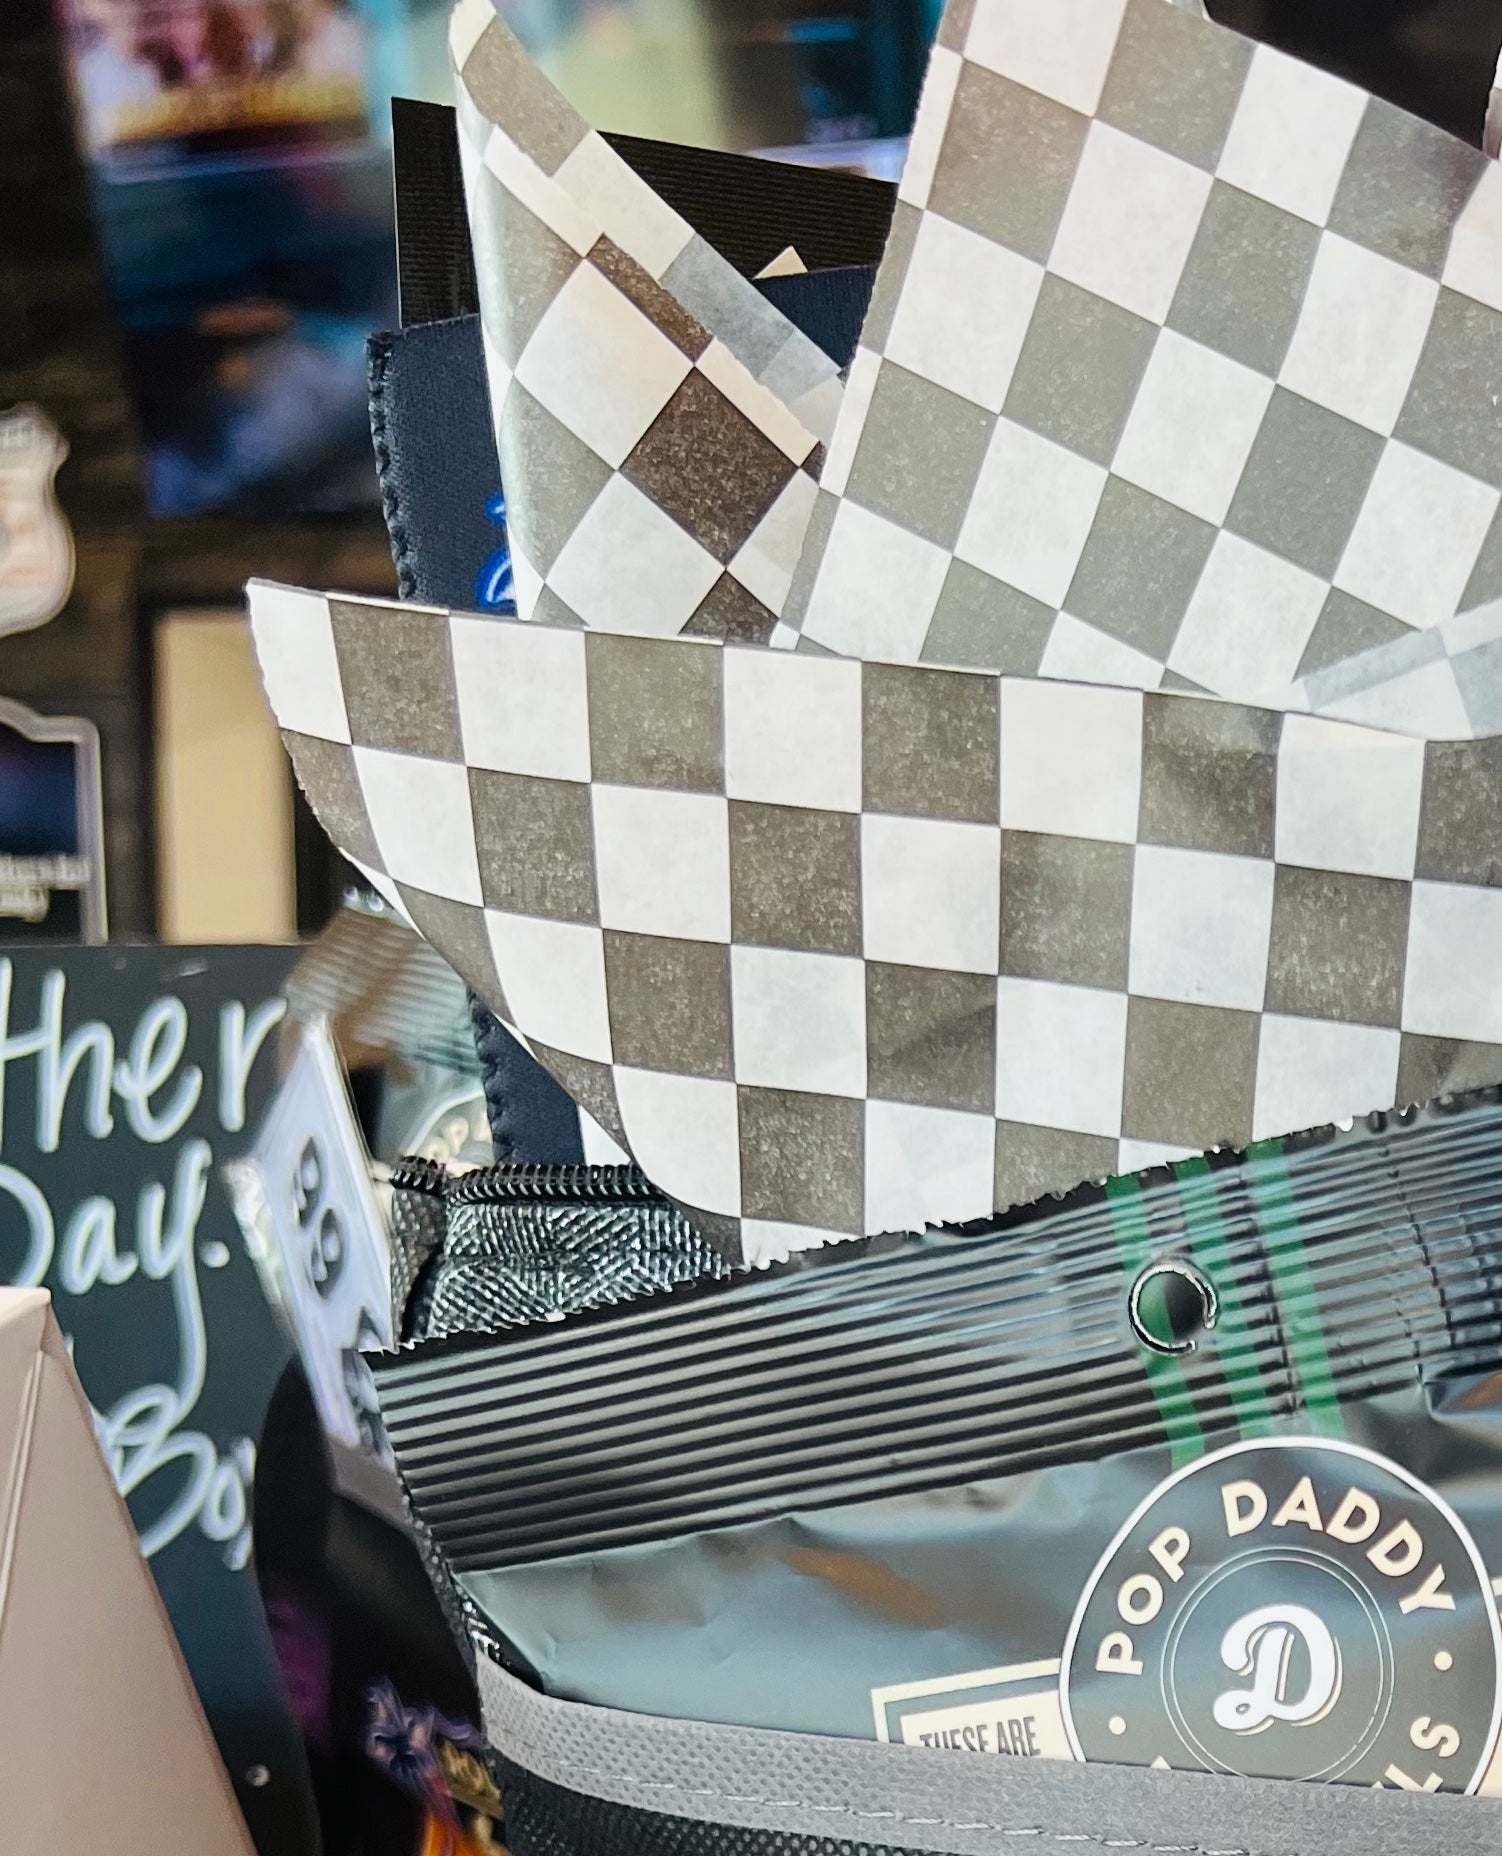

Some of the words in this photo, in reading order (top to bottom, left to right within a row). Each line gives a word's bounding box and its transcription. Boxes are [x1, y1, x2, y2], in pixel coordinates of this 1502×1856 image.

[1095, 1526, 1191, 1676] POP
[1220, 1475, 1457, 1616] DADDY
[997, 1715, 1042, 1757] ARE
